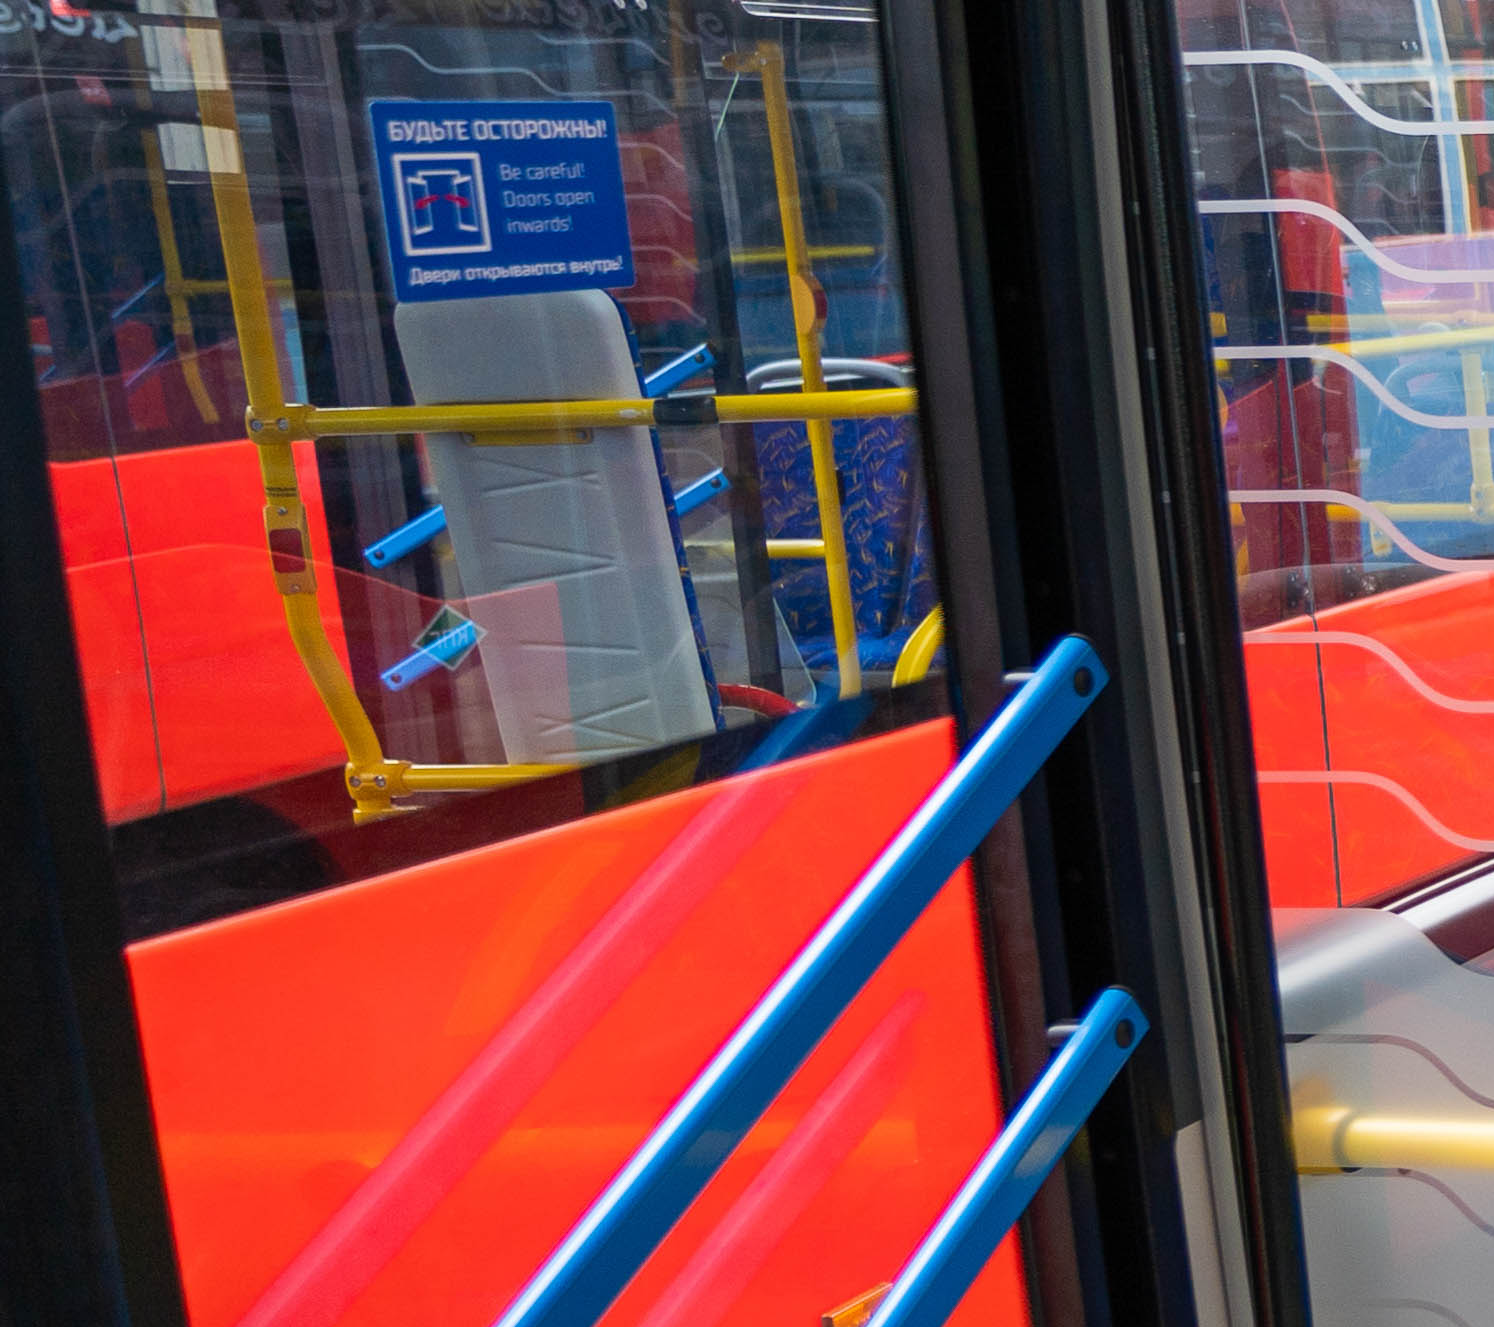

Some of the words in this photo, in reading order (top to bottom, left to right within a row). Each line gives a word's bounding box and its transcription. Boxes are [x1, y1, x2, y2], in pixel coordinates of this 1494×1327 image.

[388, 120, 470, 143] БУДЬТЕ
[473, 119, 608, 140] ОСТОРОЖНЫ!
[499, 163, 522, 181] Be
[503, 191, 552, 207] Doors
[555, 192, 595, 207] open
[409, 267, 461, 286] Двери
[465, 261, 566, 281] открываются
